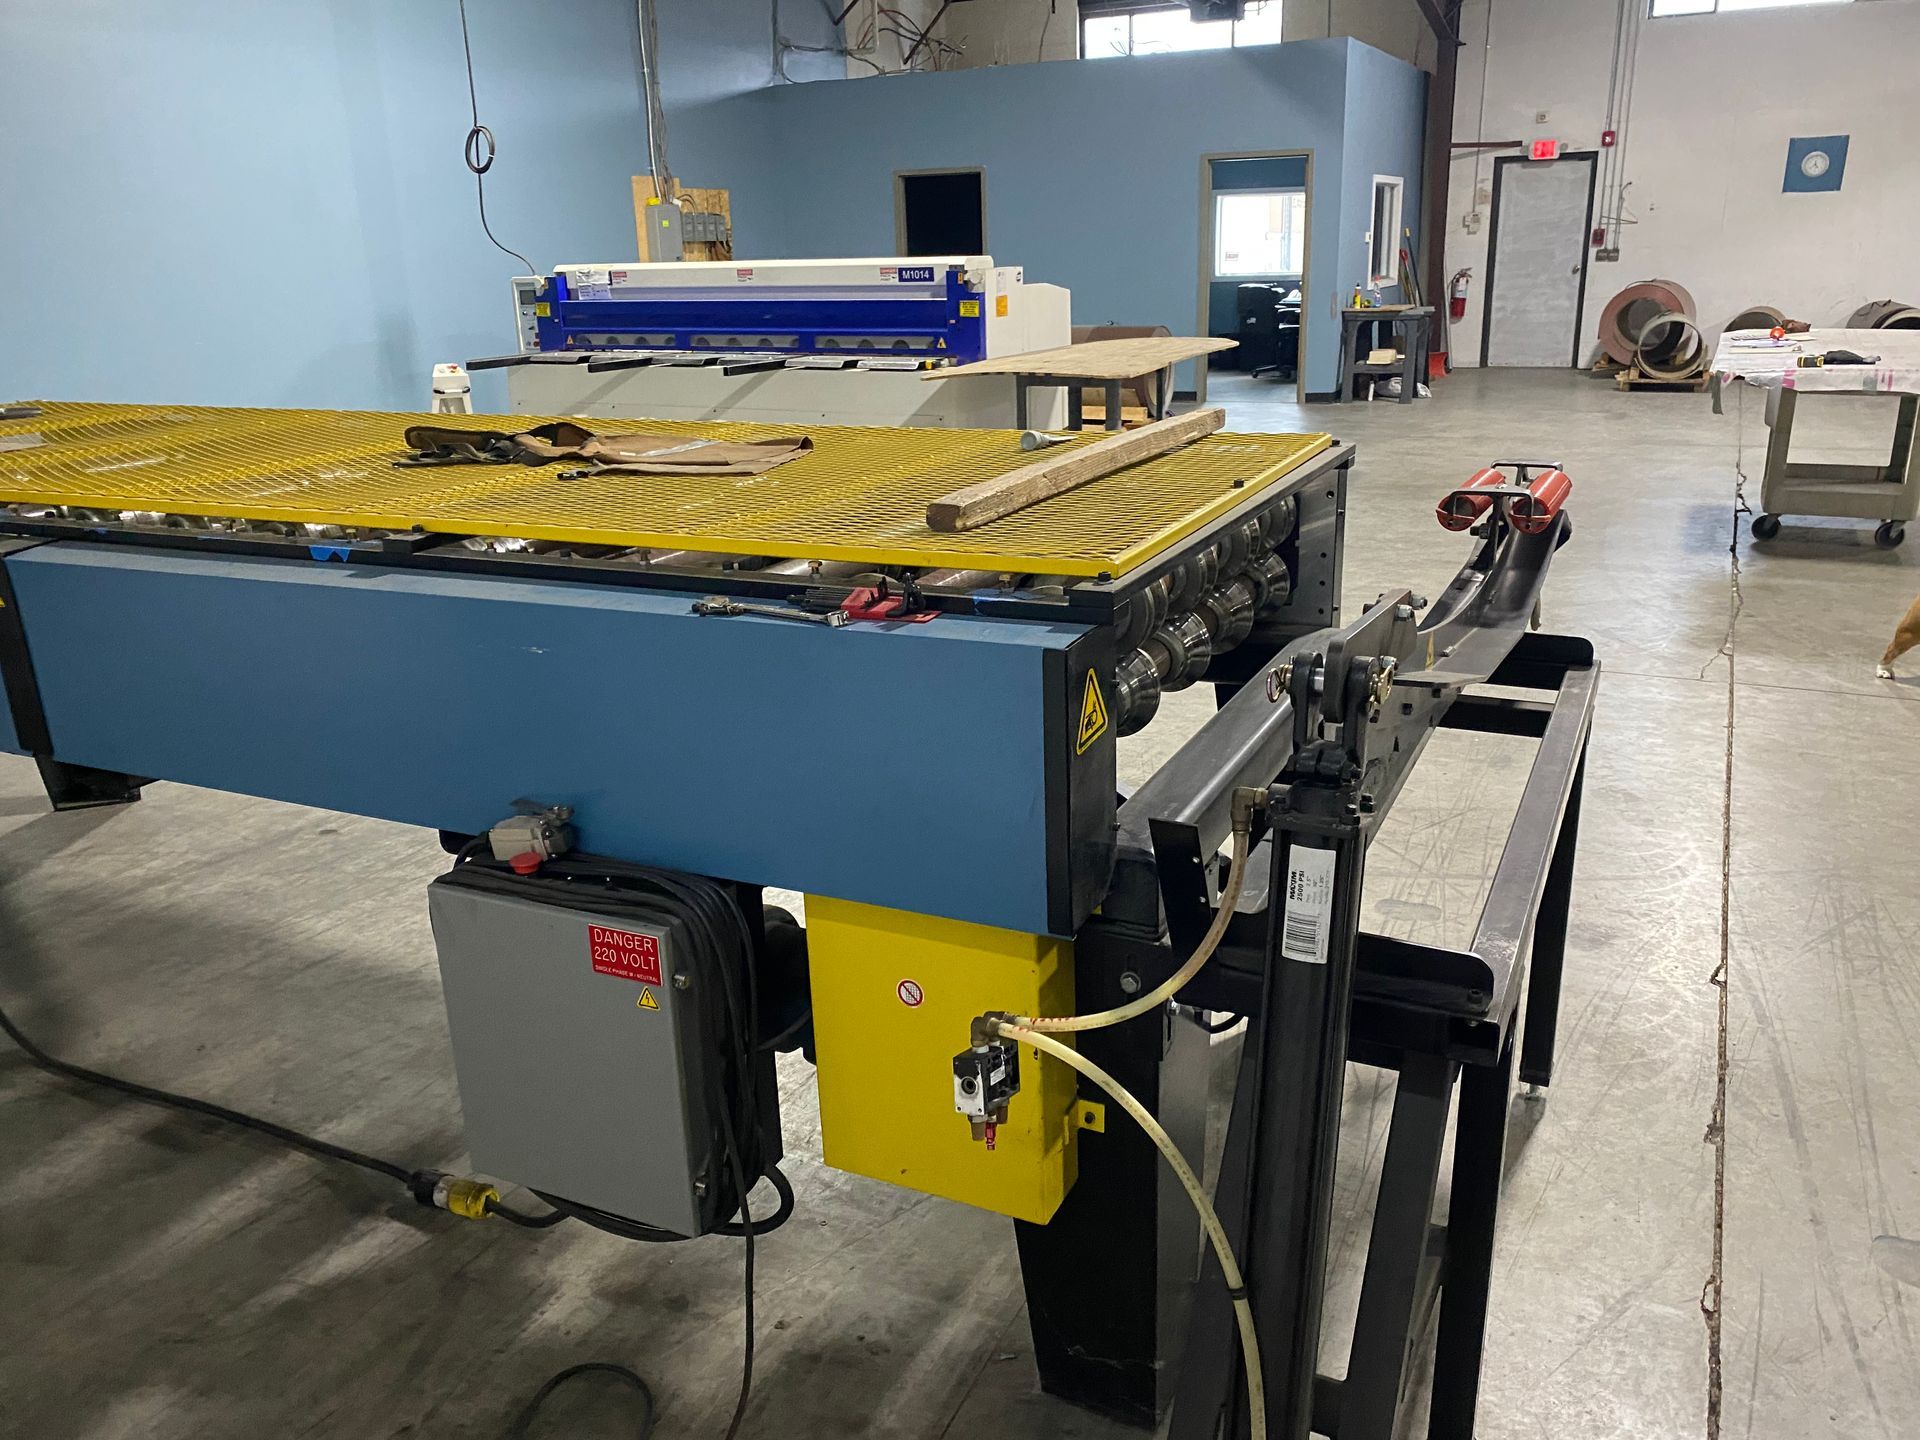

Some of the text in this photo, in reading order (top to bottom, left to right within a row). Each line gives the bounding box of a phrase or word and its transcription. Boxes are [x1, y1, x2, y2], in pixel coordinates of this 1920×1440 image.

[902, 270, 930, 279] M1014
[1290, 871, 1298, 900] MAXIM
[594, 928, 653, 952] DANGER
[594, 946, 655, 970] 220 VOLT
